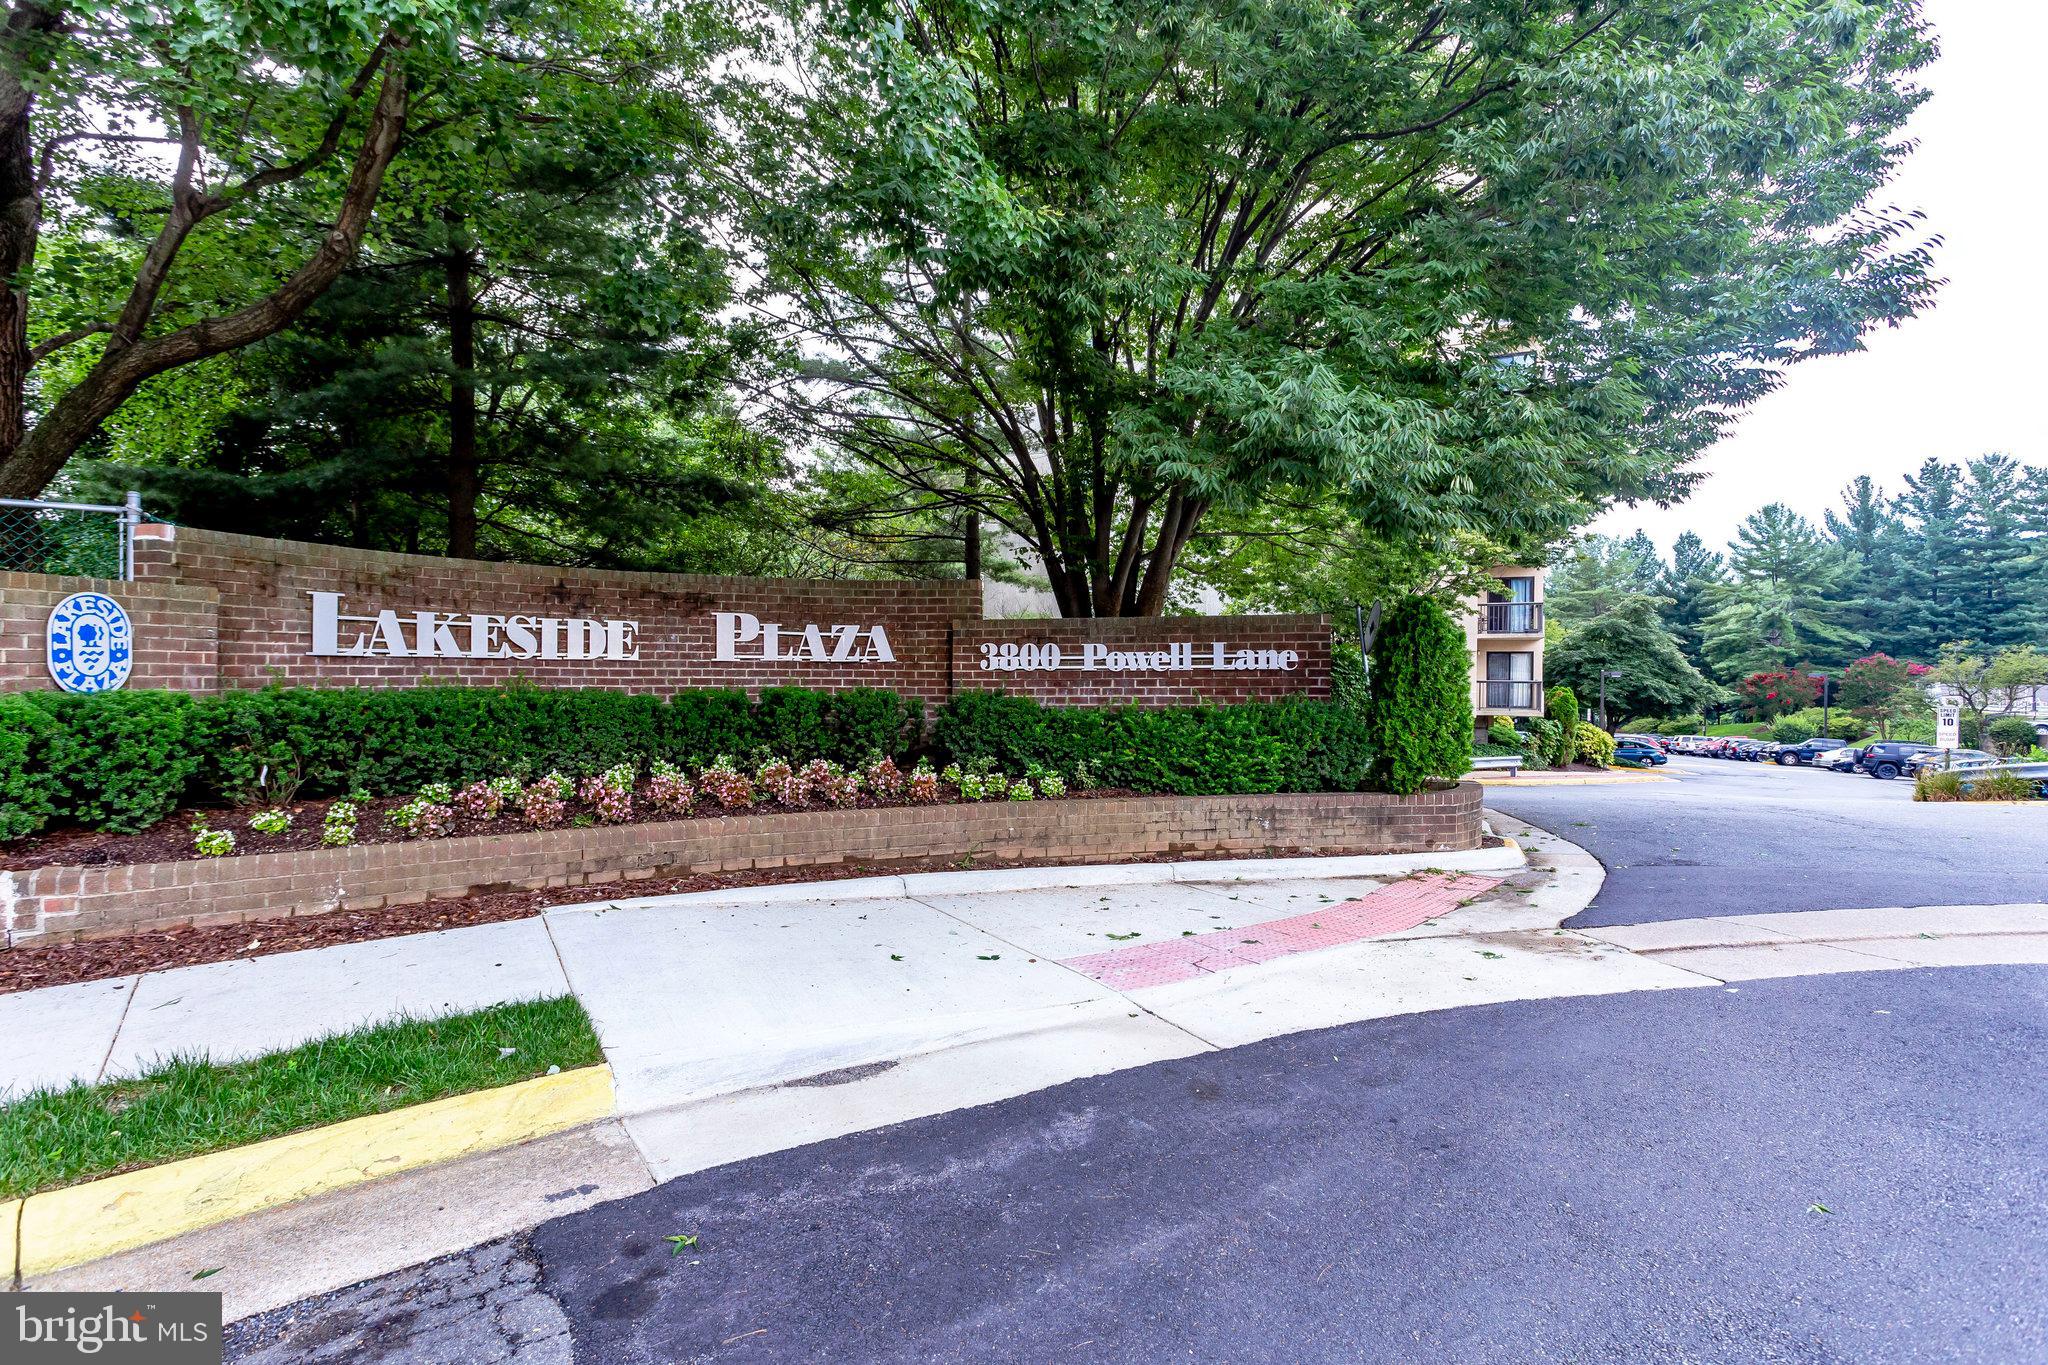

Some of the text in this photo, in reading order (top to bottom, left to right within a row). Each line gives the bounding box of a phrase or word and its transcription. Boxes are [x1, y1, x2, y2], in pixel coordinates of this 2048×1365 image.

[52, 596, 129, 650] LAKESIDE
[306, 591, 897, 662] LAKESIDE PLAZA
[980, 642, 1299, 671] 3800 Powell Lane
[53, 658, 128, 692] PLAZA
[1942, 718, 1954, 726] 10
